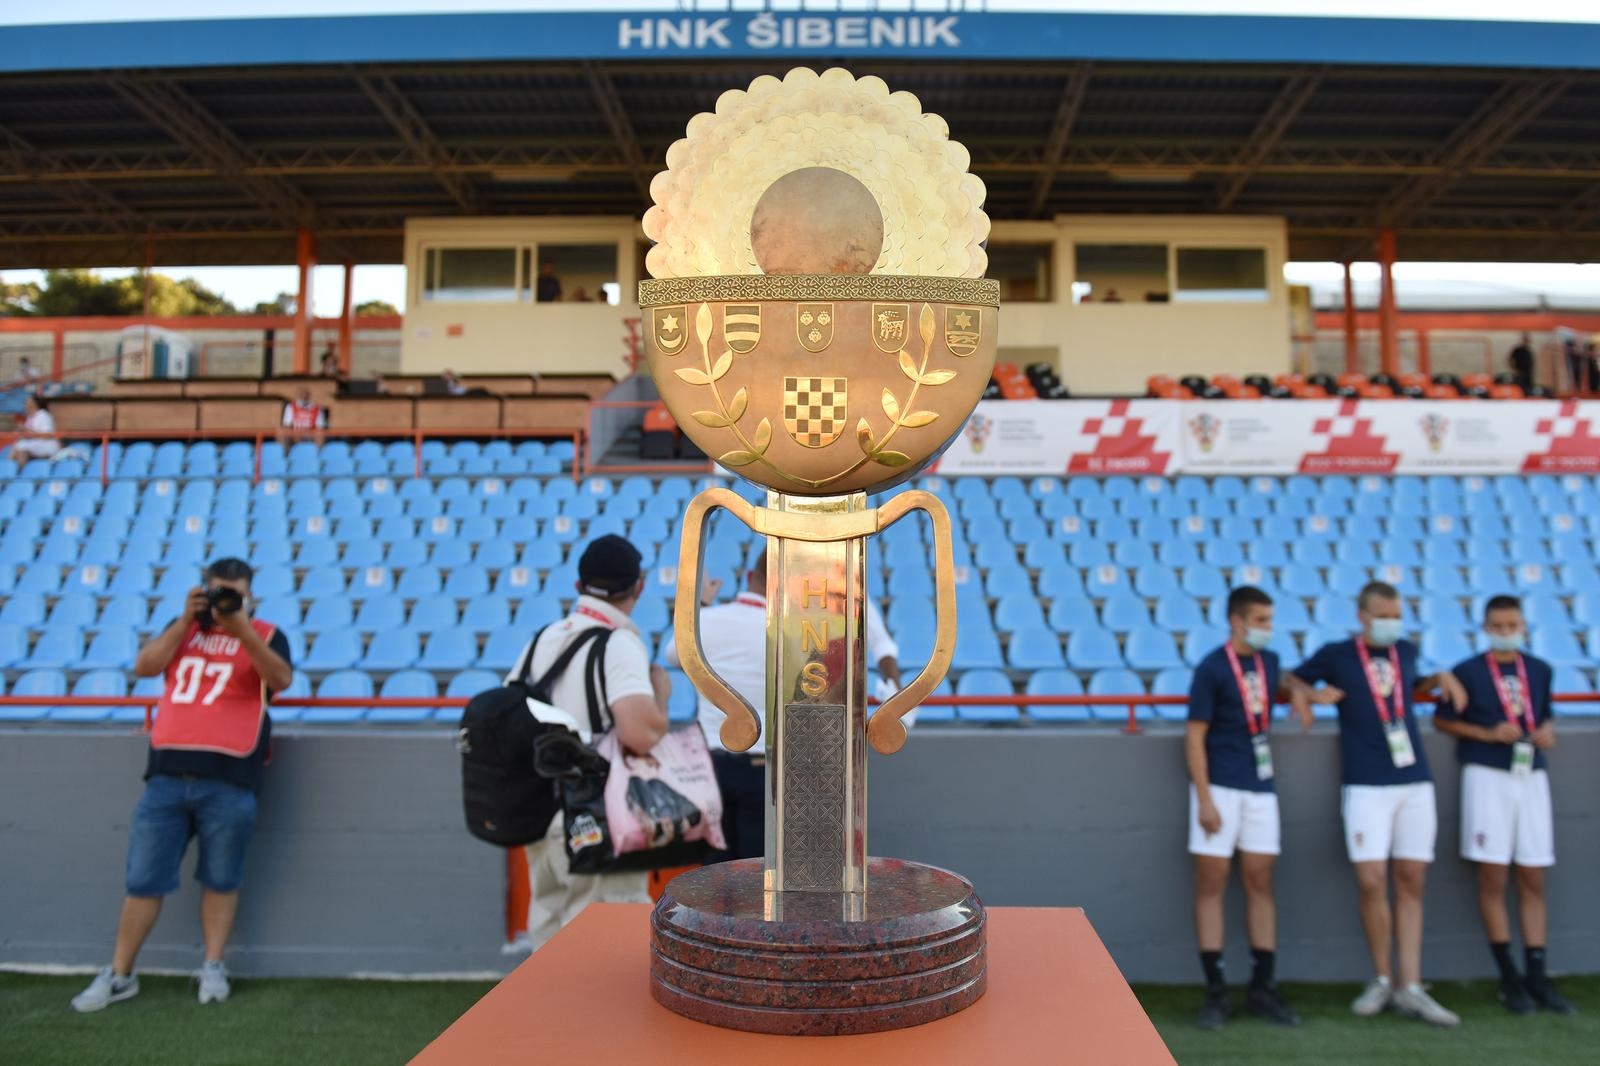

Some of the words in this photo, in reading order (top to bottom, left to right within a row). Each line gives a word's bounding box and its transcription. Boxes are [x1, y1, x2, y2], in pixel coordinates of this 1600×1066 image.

[618, 17, 732, 49] HNK
[746, 12, 961, 48] ŠIBENIK
[189, 632, 240, 655] PHOTO
[802, 578, 828, 696] HNS
[172, 657, 232, 705] 07
